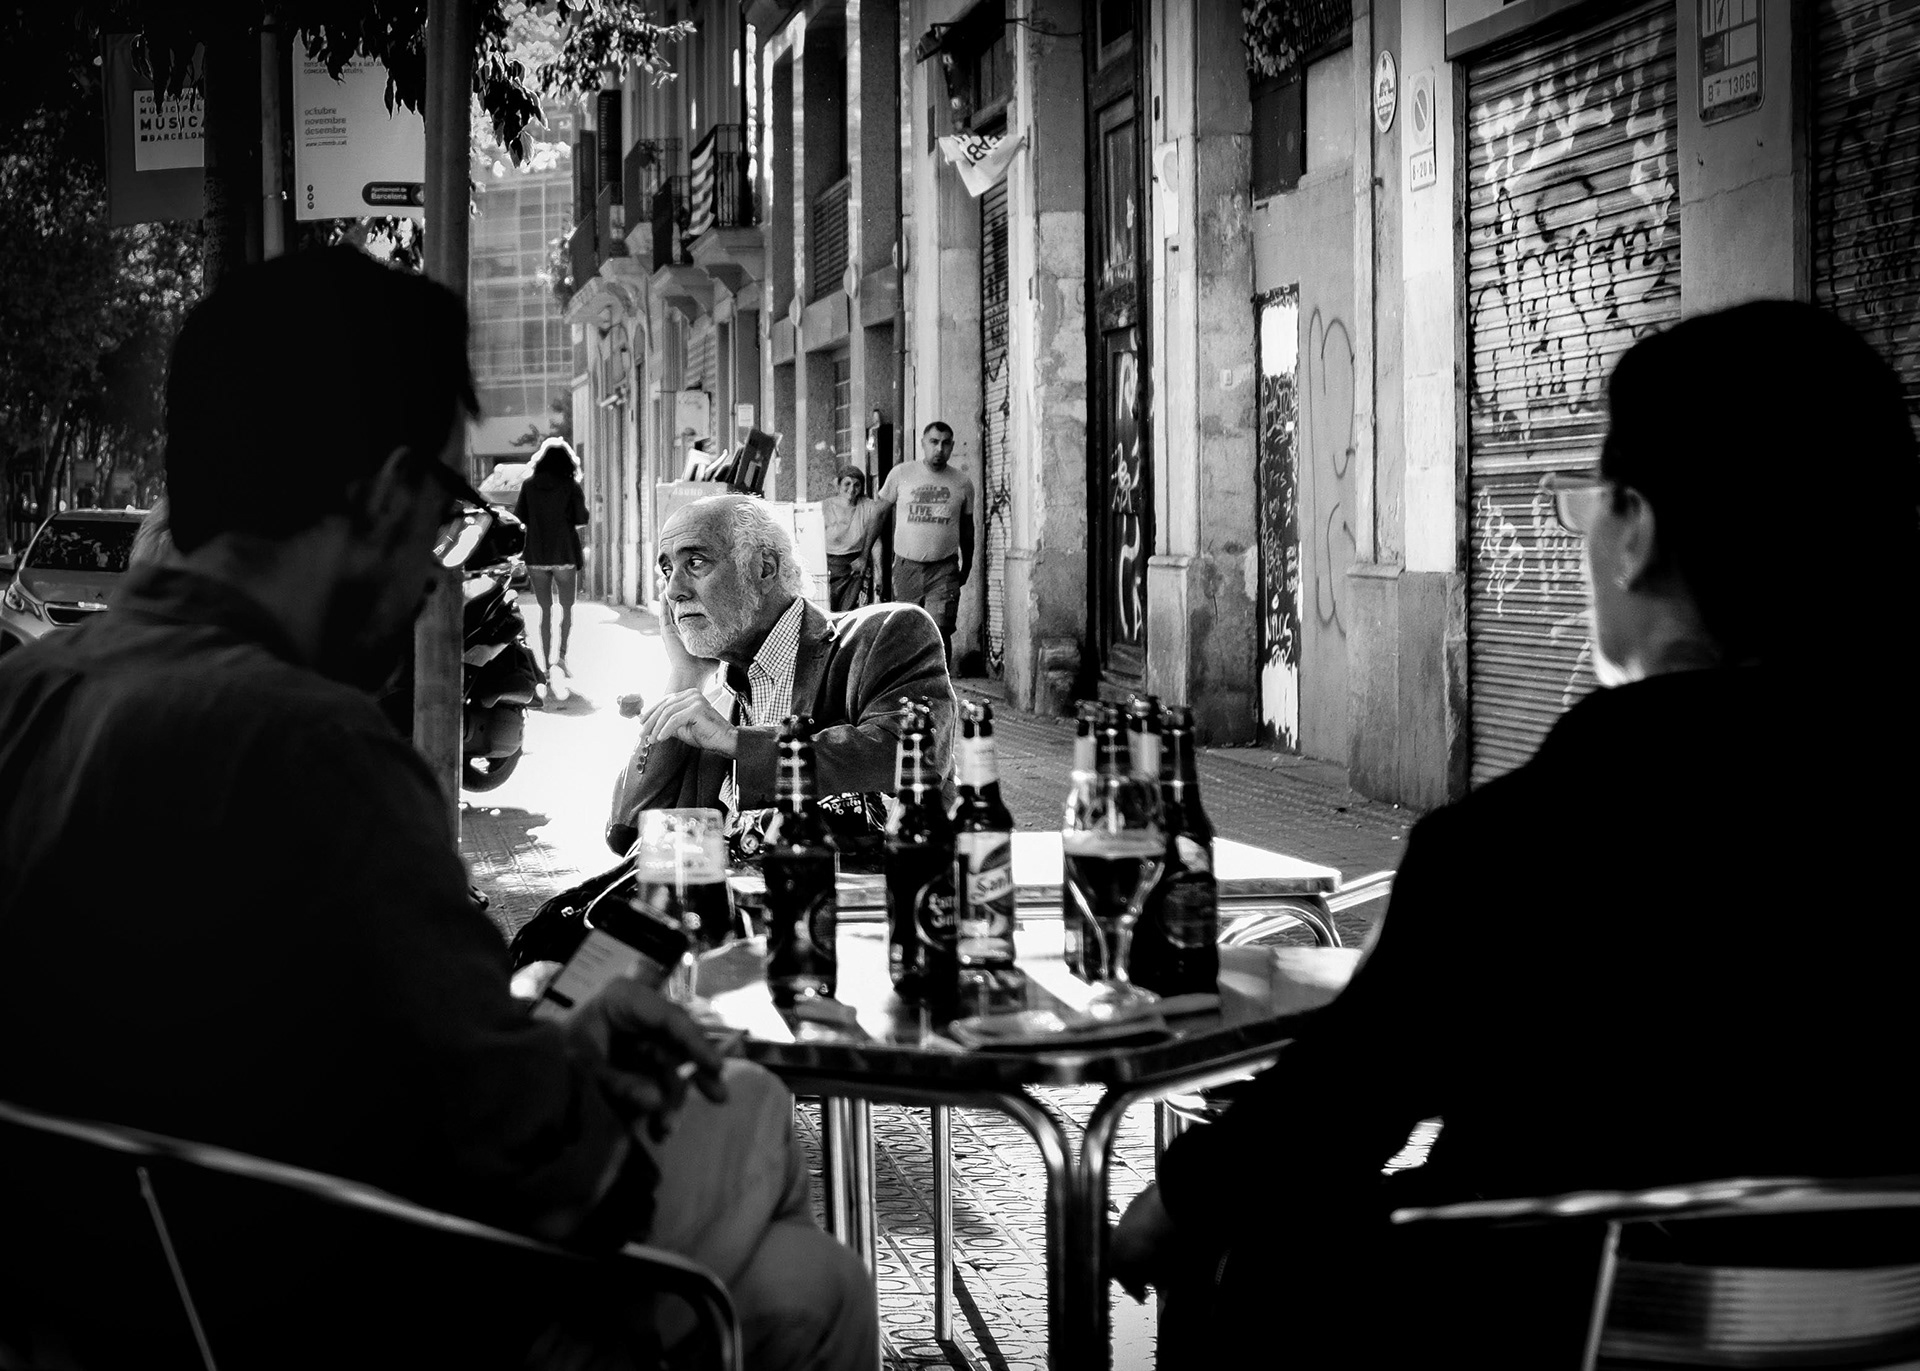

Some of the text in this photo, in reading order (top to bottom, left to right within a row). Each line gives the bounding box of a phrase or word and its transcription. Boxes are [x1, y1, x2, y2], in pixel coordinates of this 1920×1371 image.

[1729, 70, 1757, 96] 13060
[304, 107, 337, 116] octubre
[304, 117, 346, 126] novembre
[305, 127, 346, 136] desembre
[909, 504, 933, 516] LIVE
